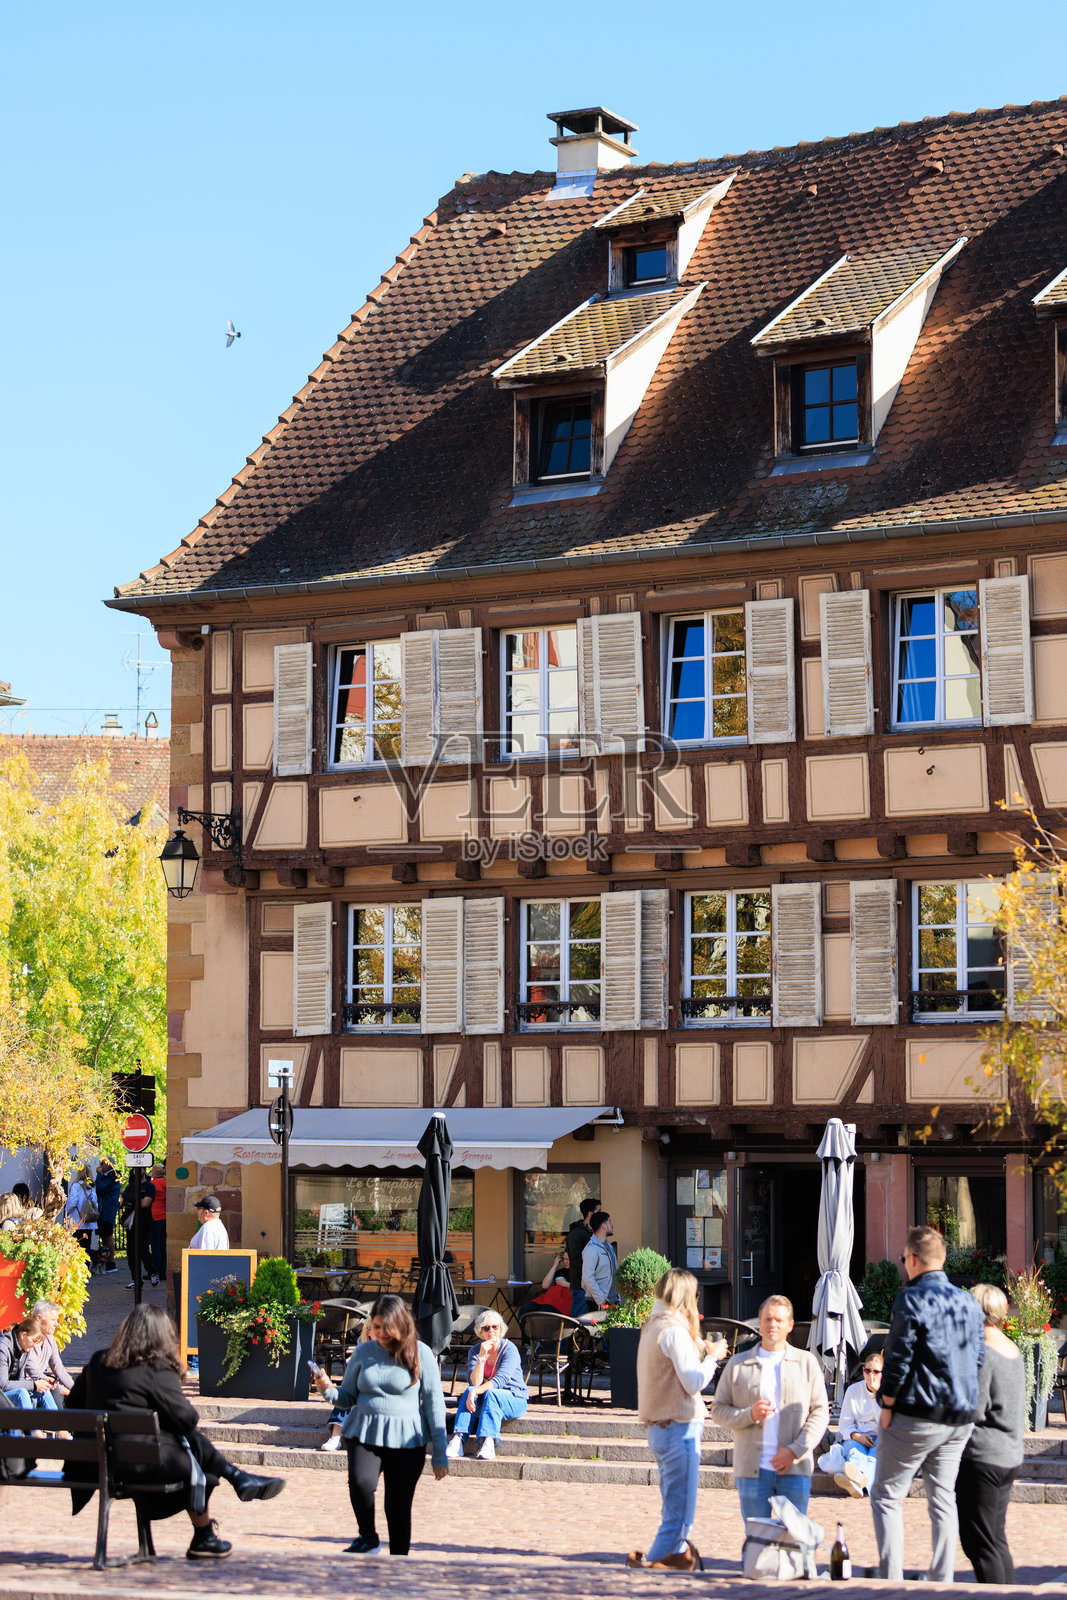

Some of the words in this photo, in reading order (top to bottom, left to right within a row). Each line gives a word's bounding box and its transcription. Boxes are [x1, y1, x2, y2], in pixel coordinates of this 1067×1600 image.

[461, 1149, 493, 1164] Georges
[347, 1177, 363, 1188] Le
[351, 1189, 366, 1203] de
